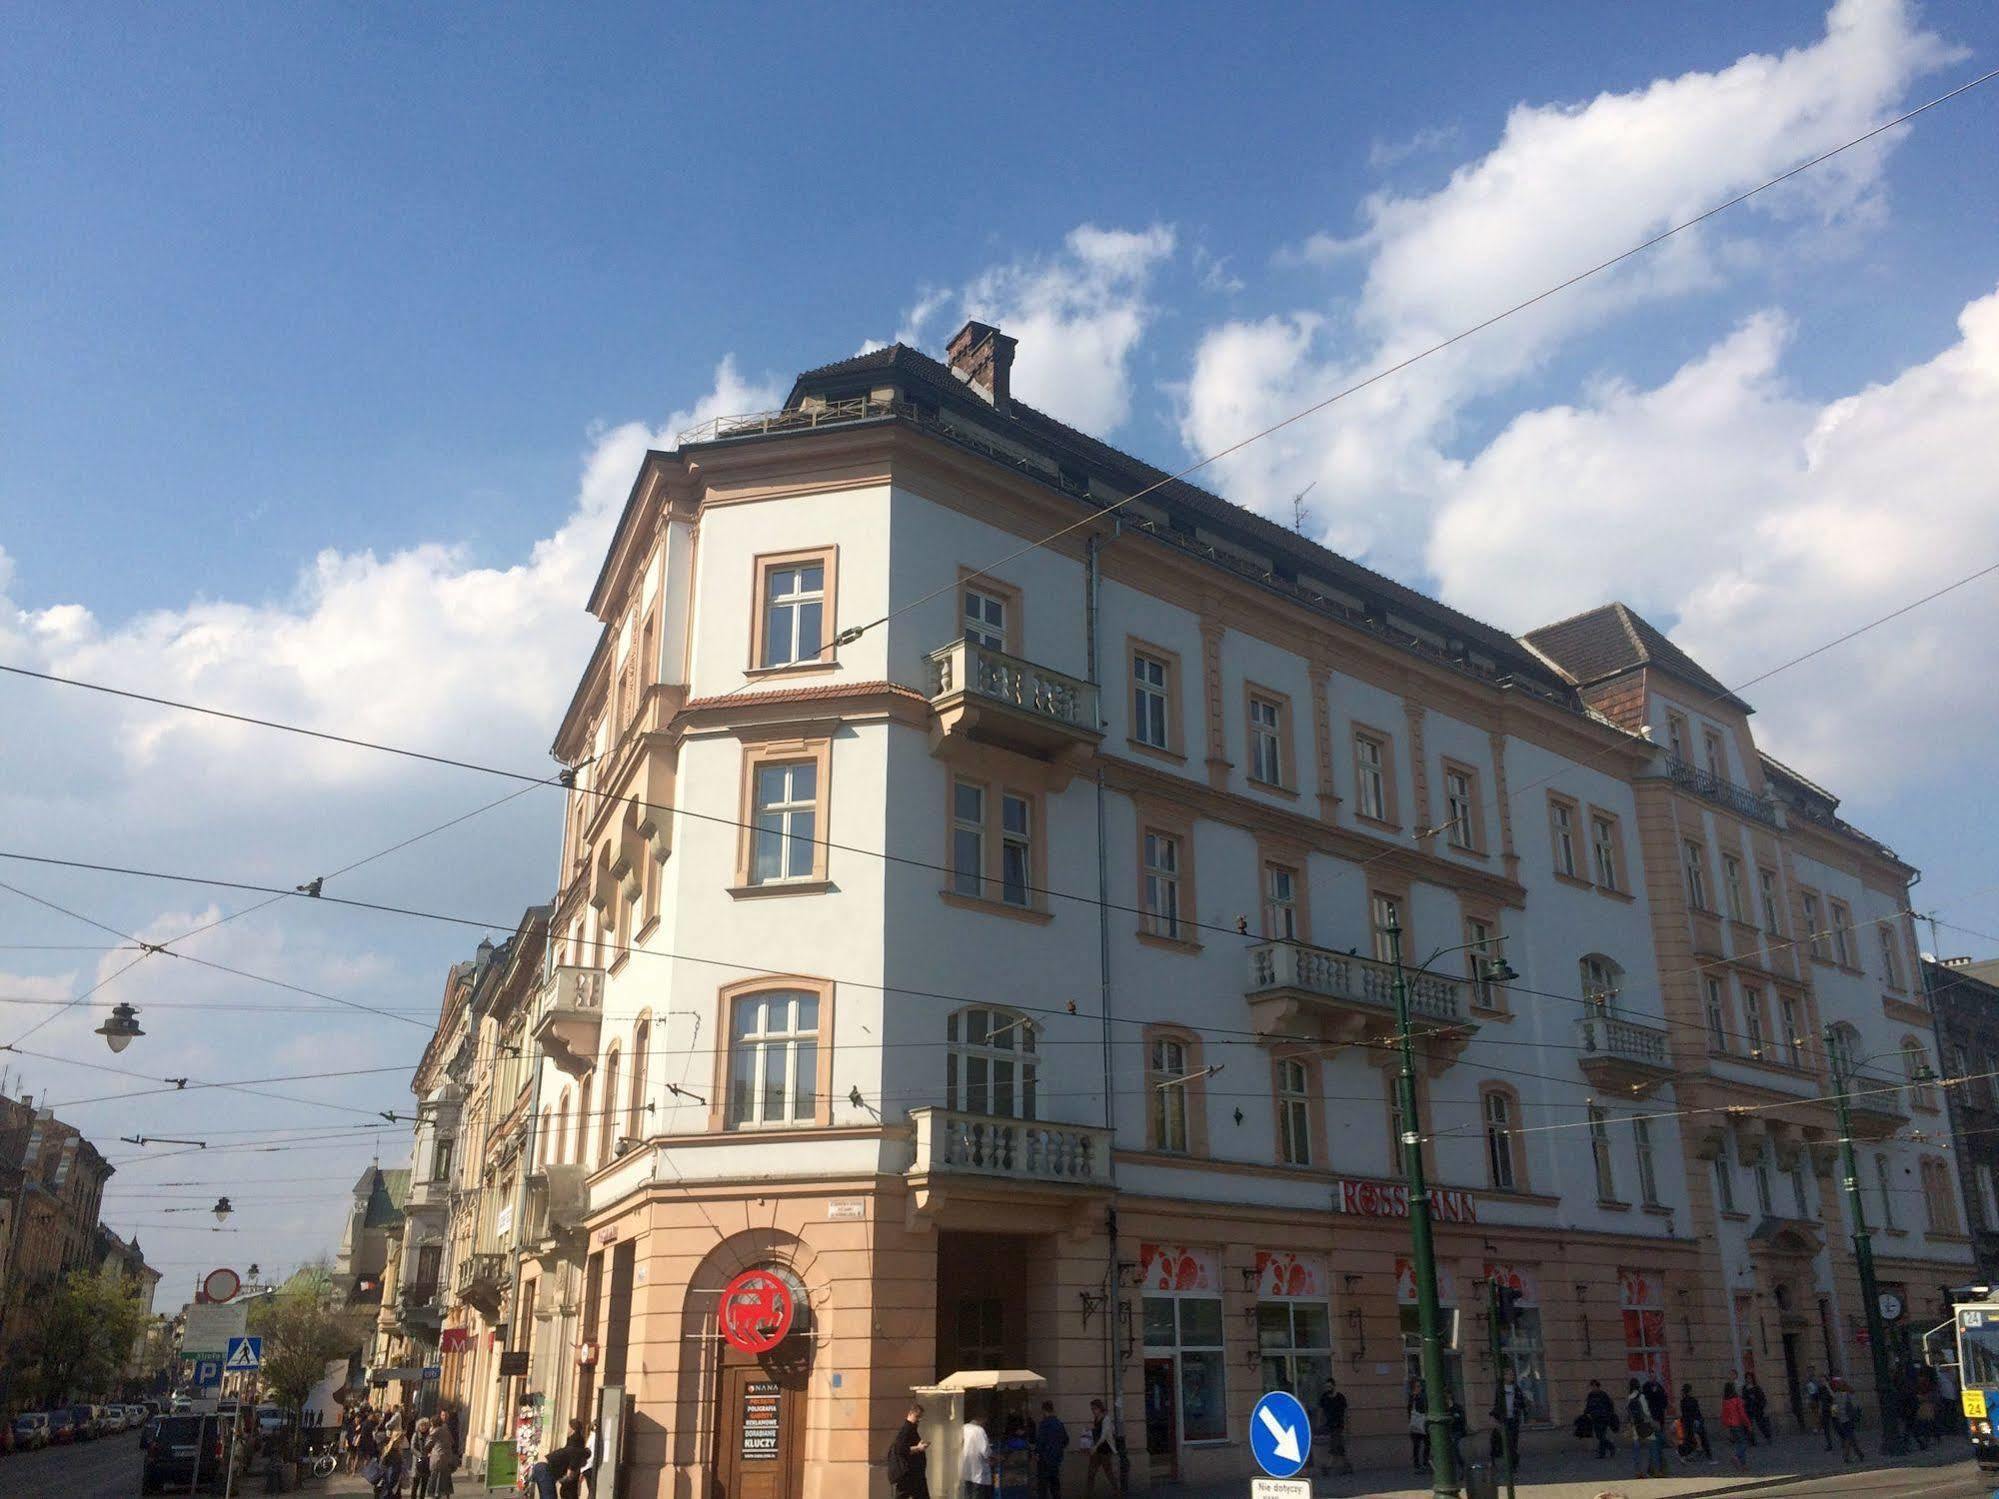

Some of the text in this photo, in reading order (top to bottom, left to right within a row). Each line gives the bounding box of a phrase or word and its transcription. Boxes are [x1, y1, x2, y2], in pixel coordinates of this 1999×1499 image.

[1339, 1180, 1477, 1222] ROSSANN
[1968, 1404, 1981, 1415] 24
[744, 1439, 776, 1448] KLUCZY
[1258, 1483, 1303, 1495] Nie dotyczy
